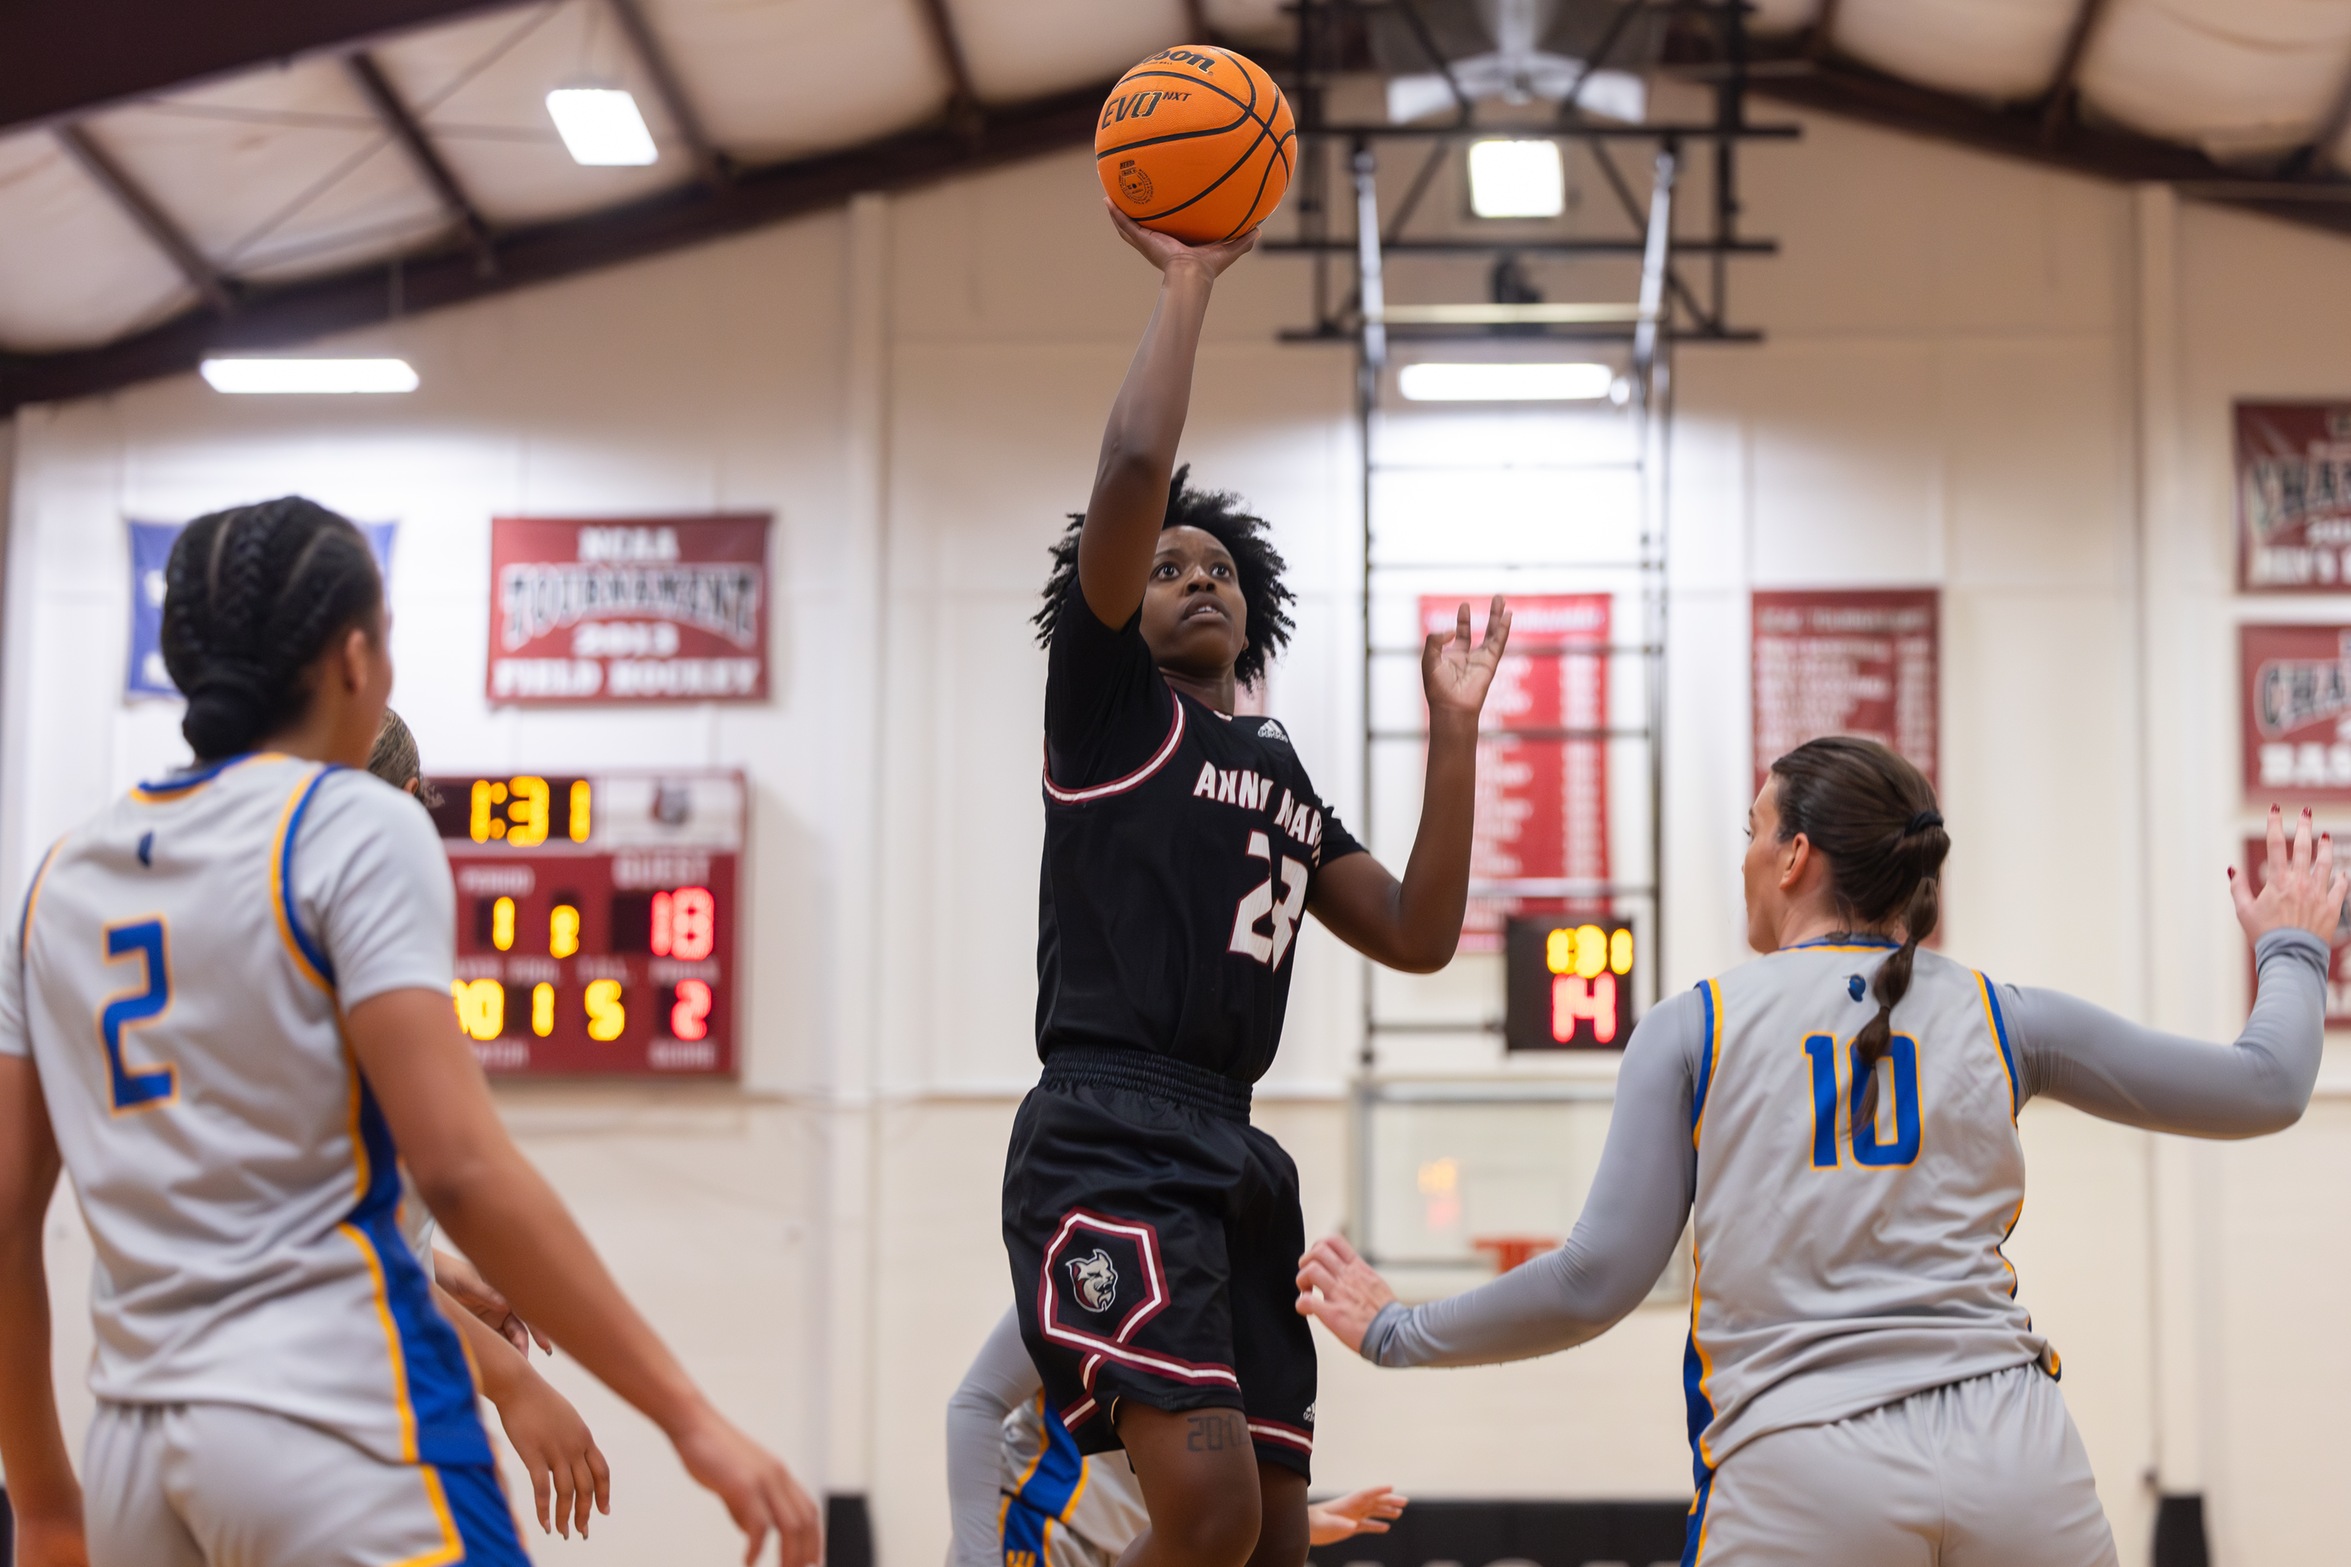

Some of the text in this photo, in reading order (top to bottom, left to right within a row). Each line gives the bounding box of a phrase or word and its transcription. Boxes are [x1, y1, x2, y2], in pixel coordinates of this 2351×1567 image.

[1101, 90, 1192, 130] EVO NXT
[492, 656, 761, 697] FIELD HOCKEY
[470, 776, 591, 847] 1:31
[651, 886, 715, 961] 18
[97, 913, 181, 1118] 2
[584, 979, 625, 1041] 5
[671, 978, 712, 1041] 2
[1802, 1031, 1924, 1171] 10
